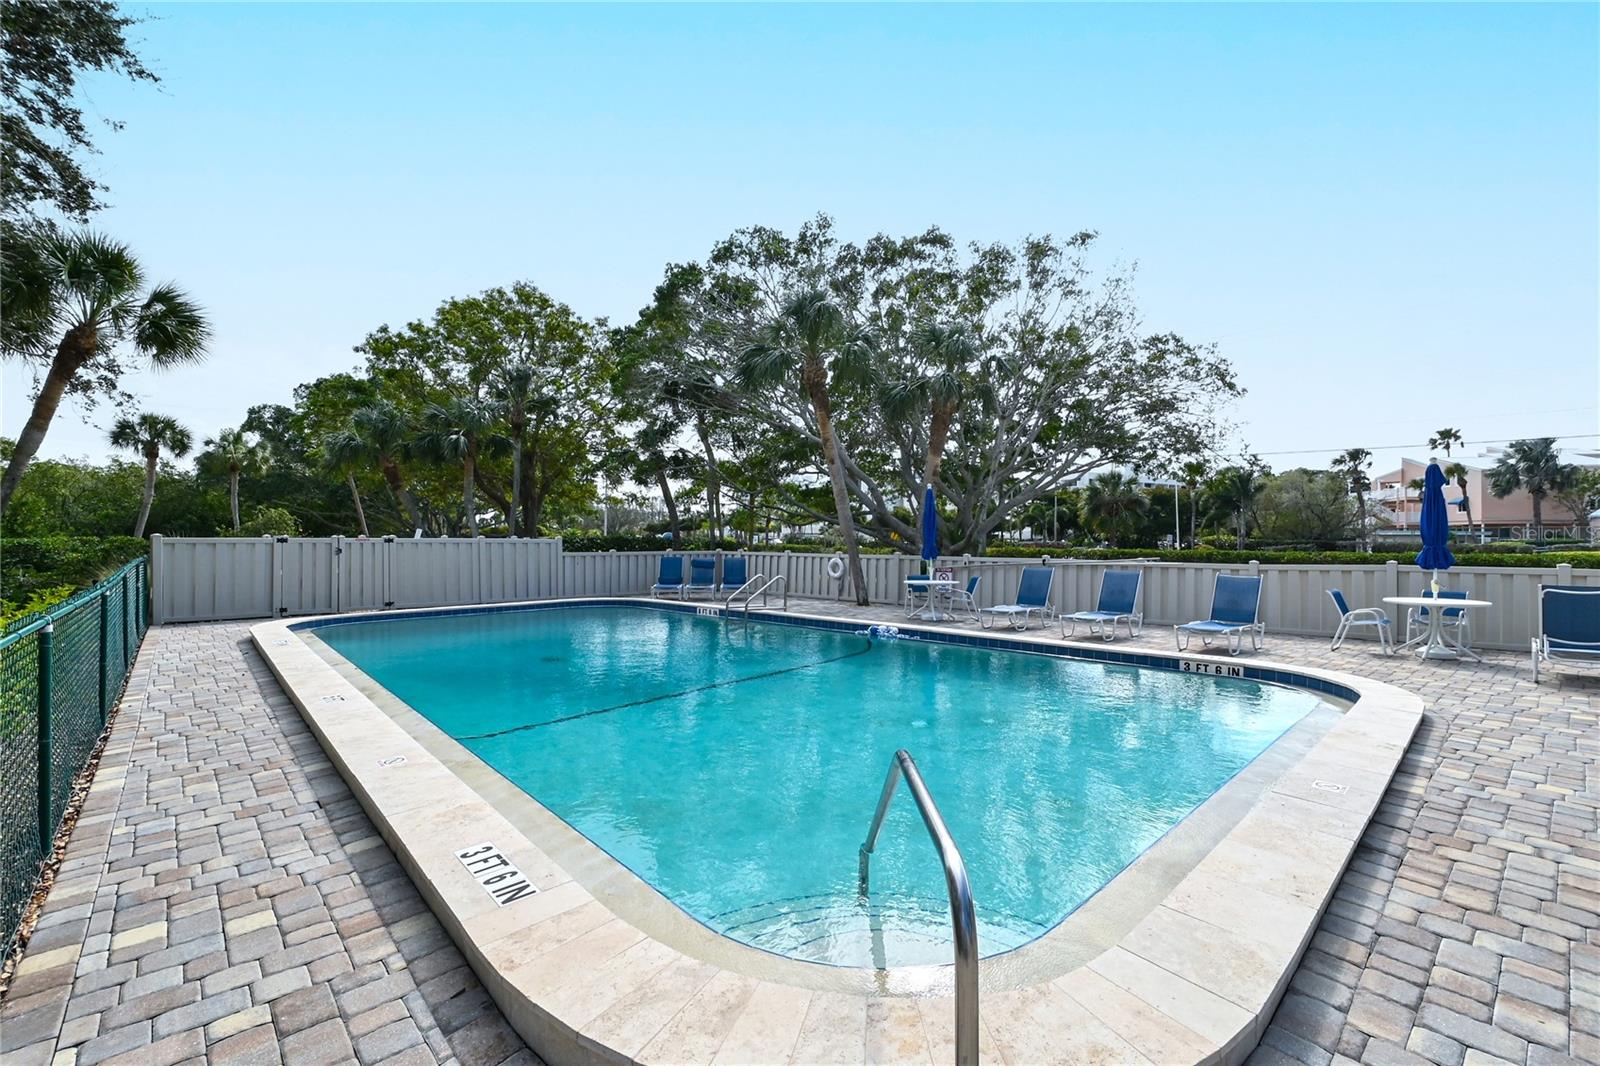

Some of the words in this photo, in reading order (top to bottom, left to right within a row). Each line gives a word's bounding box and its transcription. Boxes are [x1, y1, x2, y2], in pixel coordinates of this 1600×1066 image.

[1183, 662, 1191, 672] 3
[1196, 663, 1209, 673] FT
[1215, 665, 1222, 675] 6
[1227, 667, 1240, 677] IN
[459, 846, 494, 859] 3
[466, 853, 510, 875] FT
[482, 870, 519, 886] 6
[491, 879, 537, 905] IN
